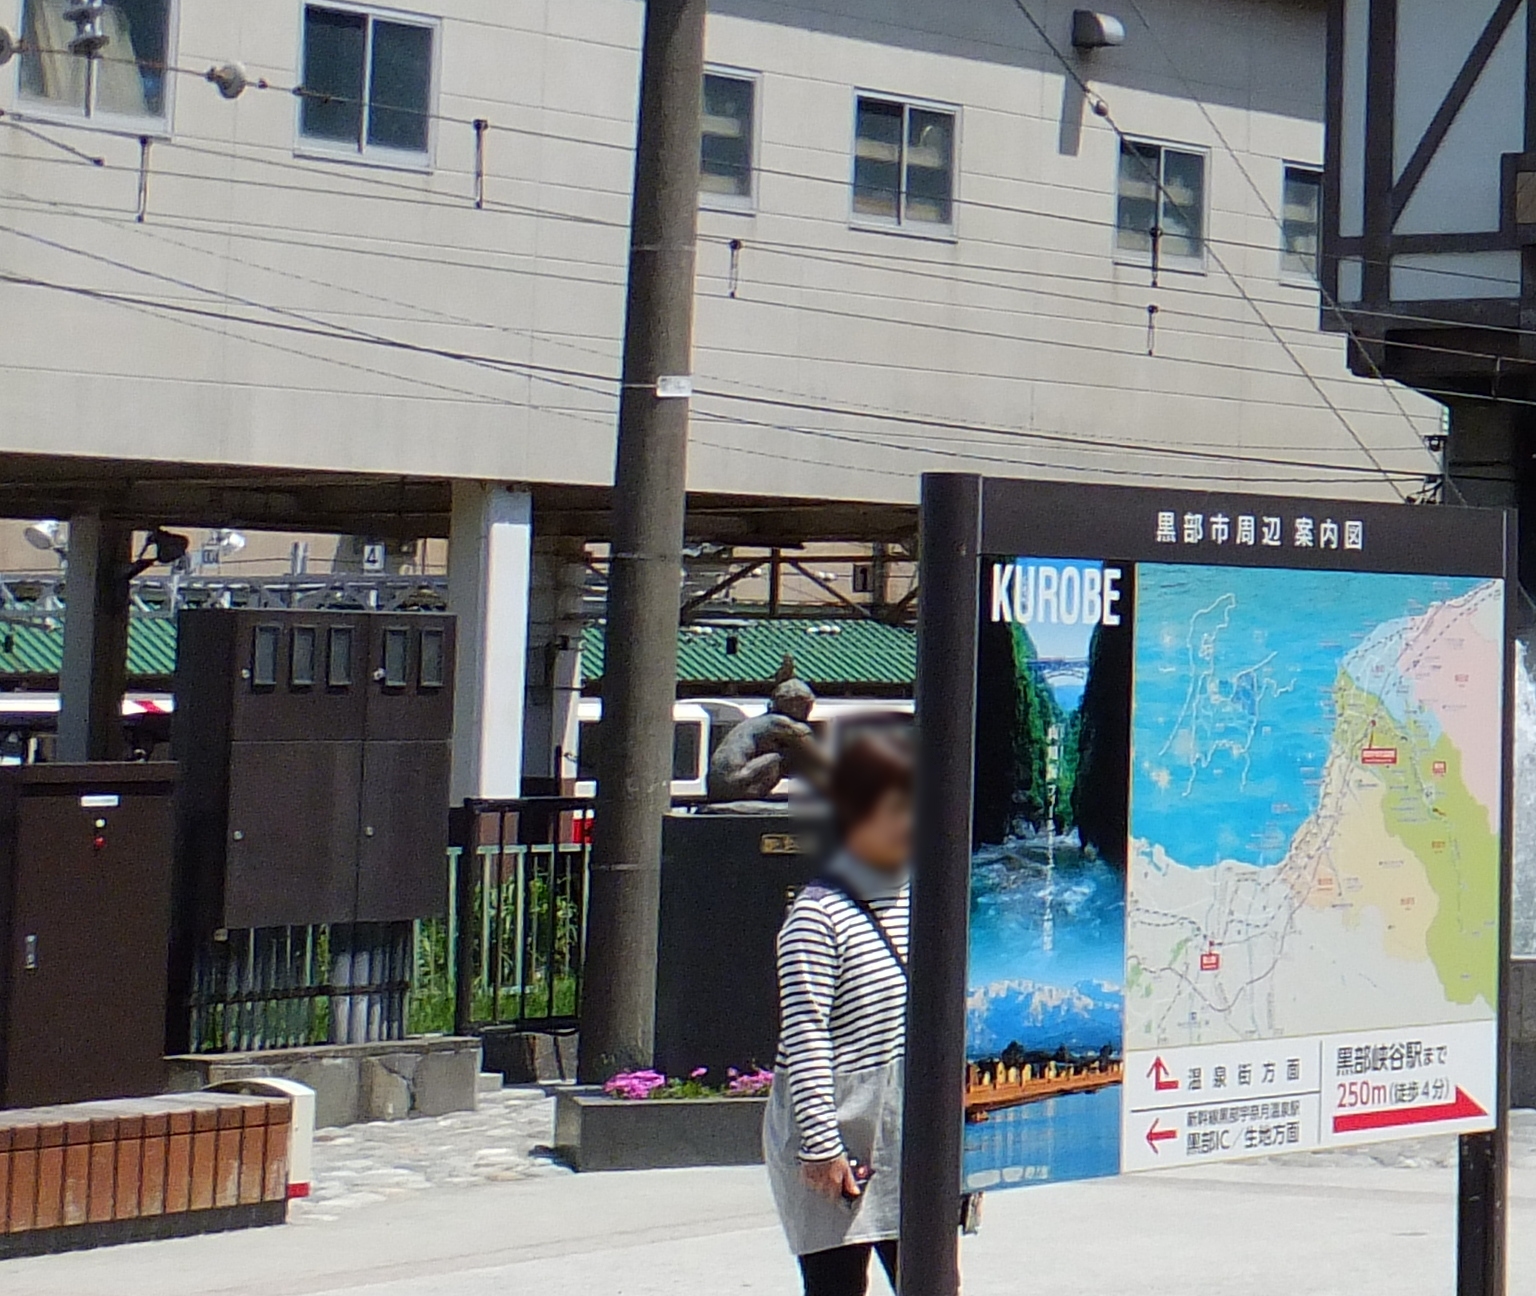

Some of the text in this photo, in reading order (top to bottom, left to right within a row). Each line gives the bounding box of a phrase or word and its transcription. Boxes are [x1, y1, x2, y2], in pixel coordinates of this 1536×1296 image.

[1156, 511, 1364, 551] 黒部市周辺 案内図
[364, 547, 379, 565] 4
[859, 567, 869, 591] 1
[991, 563, 1122, 625] KUROBE
[1187, 1058, 1300, 1091] 温泉街方面
[1336, 1041, 1448, 1077] 黒部峡谷駅まで
